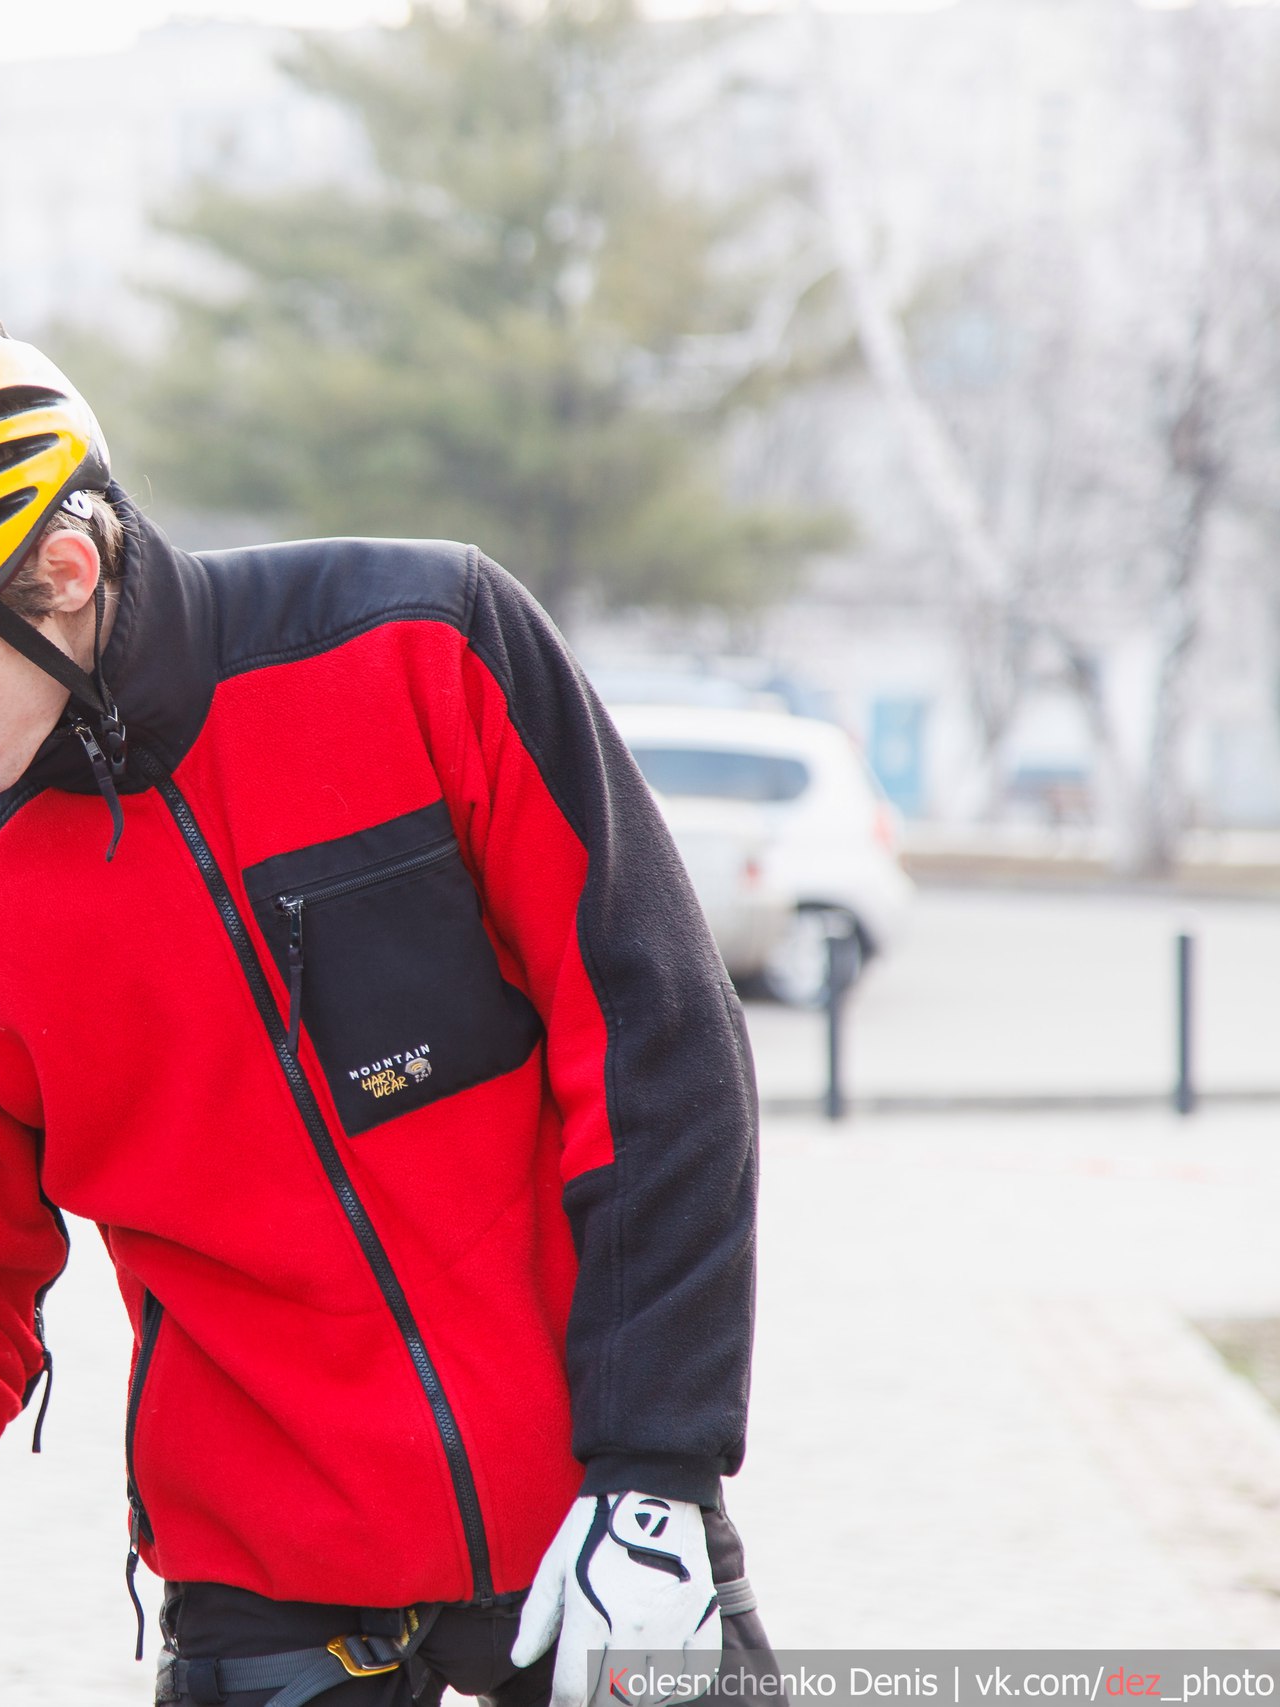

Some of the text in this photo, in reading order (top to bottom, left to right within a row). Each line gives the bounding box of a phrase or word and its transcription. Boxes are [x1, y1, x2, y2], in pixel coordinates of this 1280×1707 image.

[349, 1043, 430, 1080] MOUNTAIN
[362, 1069, 396, 1091] HARD
[373, 1076, 408, 1098] WEAR
